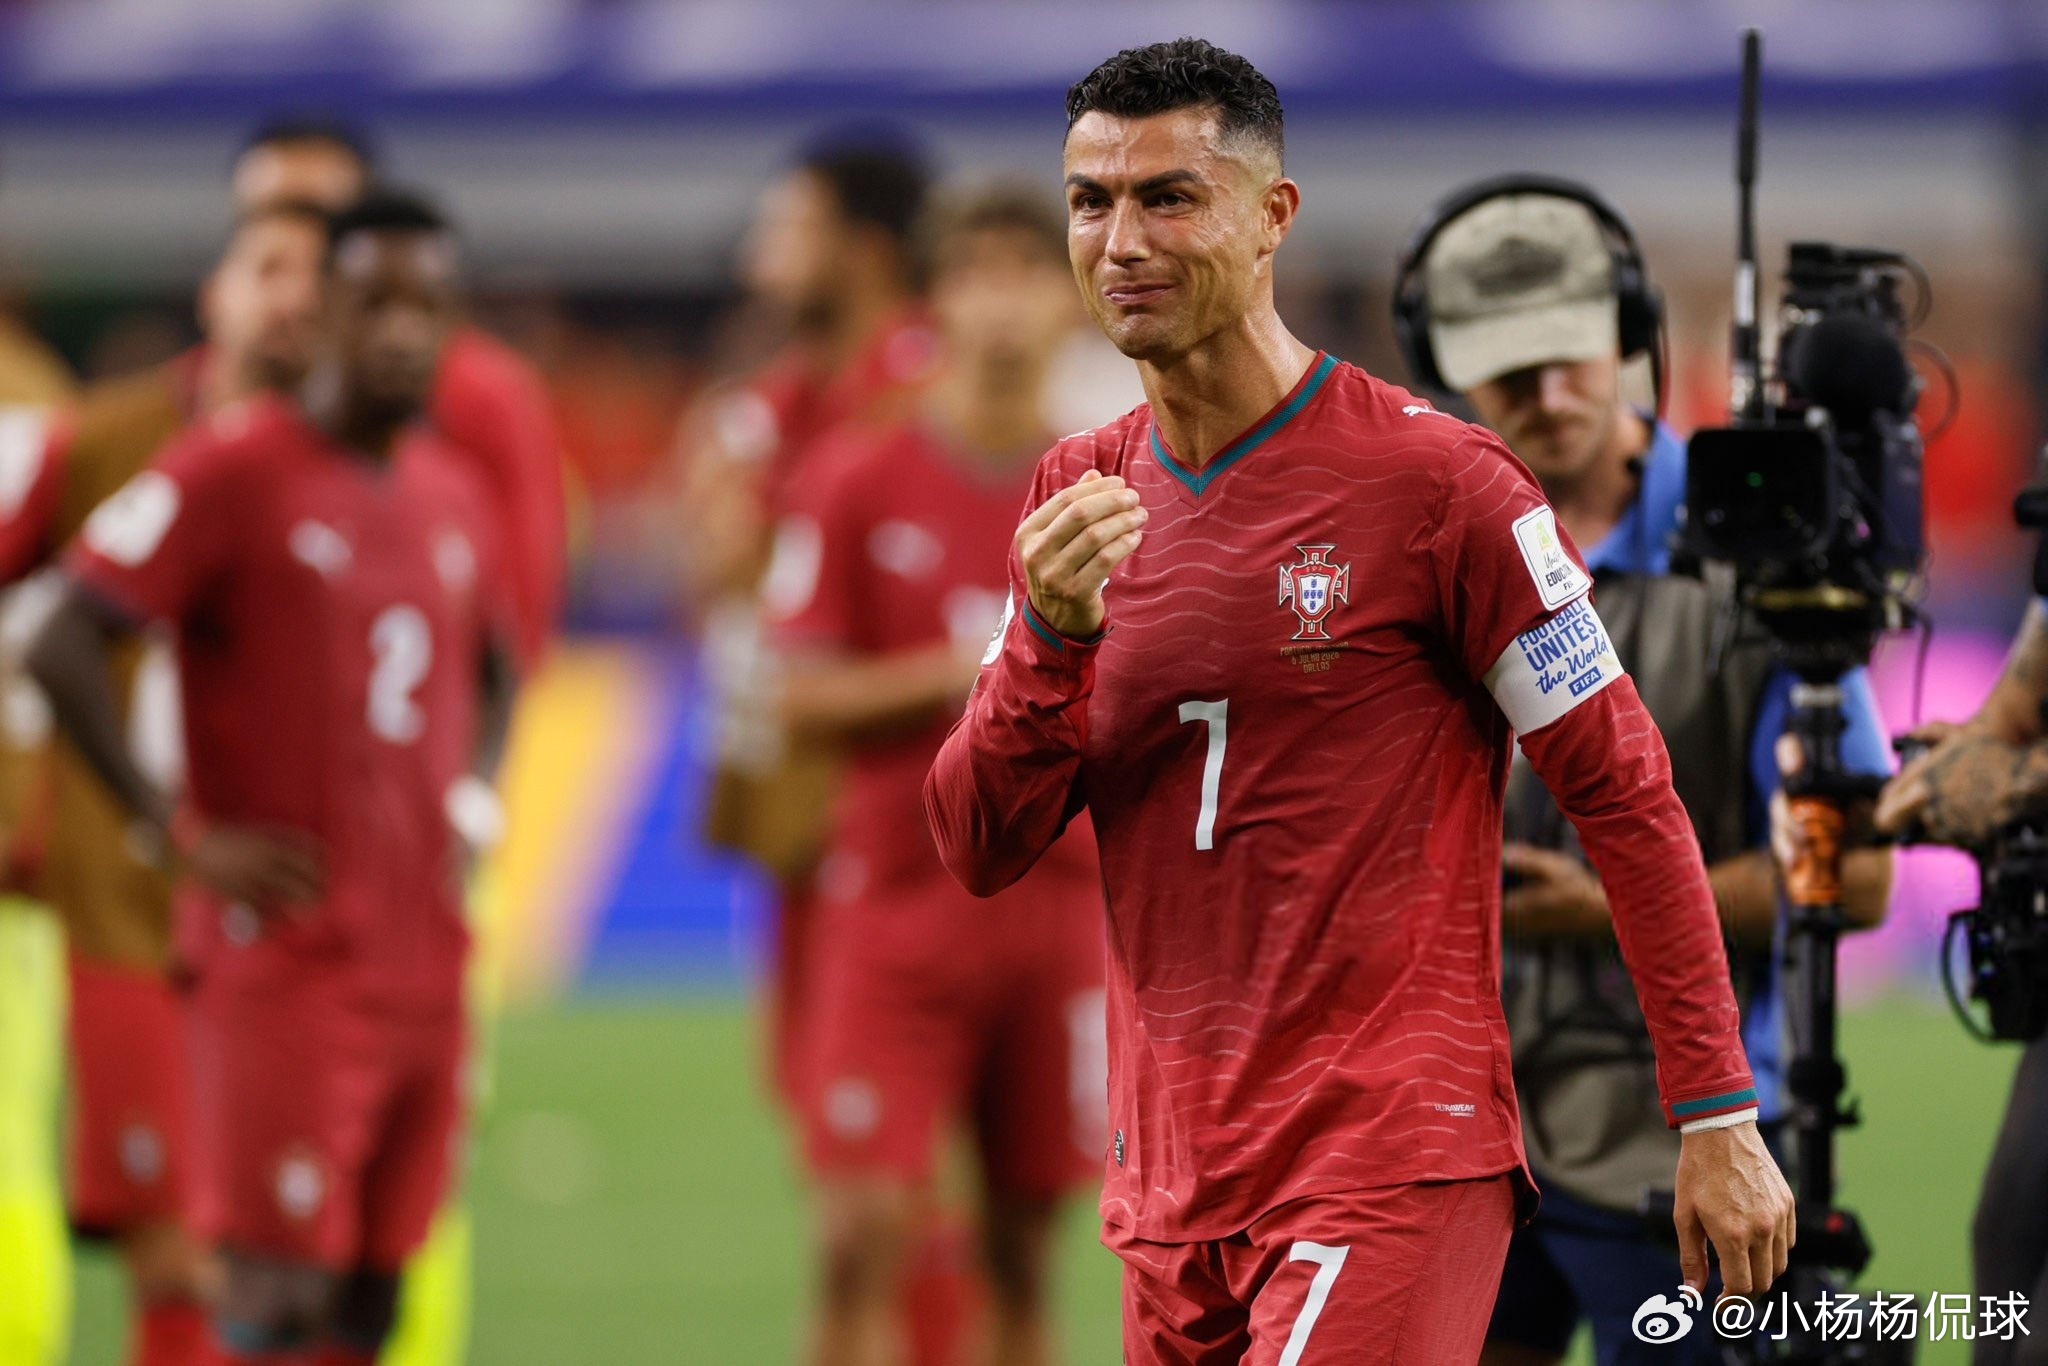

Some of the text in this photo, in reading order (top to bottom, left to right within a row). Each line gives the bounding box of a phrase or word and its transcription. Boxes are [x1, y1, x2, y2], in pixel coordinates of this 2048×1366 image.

[1517, 600, 1586, 651] FOOTBALL
[1526, 613, 1597, 671] UNITES
[367, 603, 432, 745] 2
[1303, 661, 1330, 674] DALLAS
[1535, 633, 1609, 694] the World
[1572, 671, 1599, 692] FIFA
[1178, 698, 1228, 850] 7
[1278, 1241, 1350, 1366] 7
